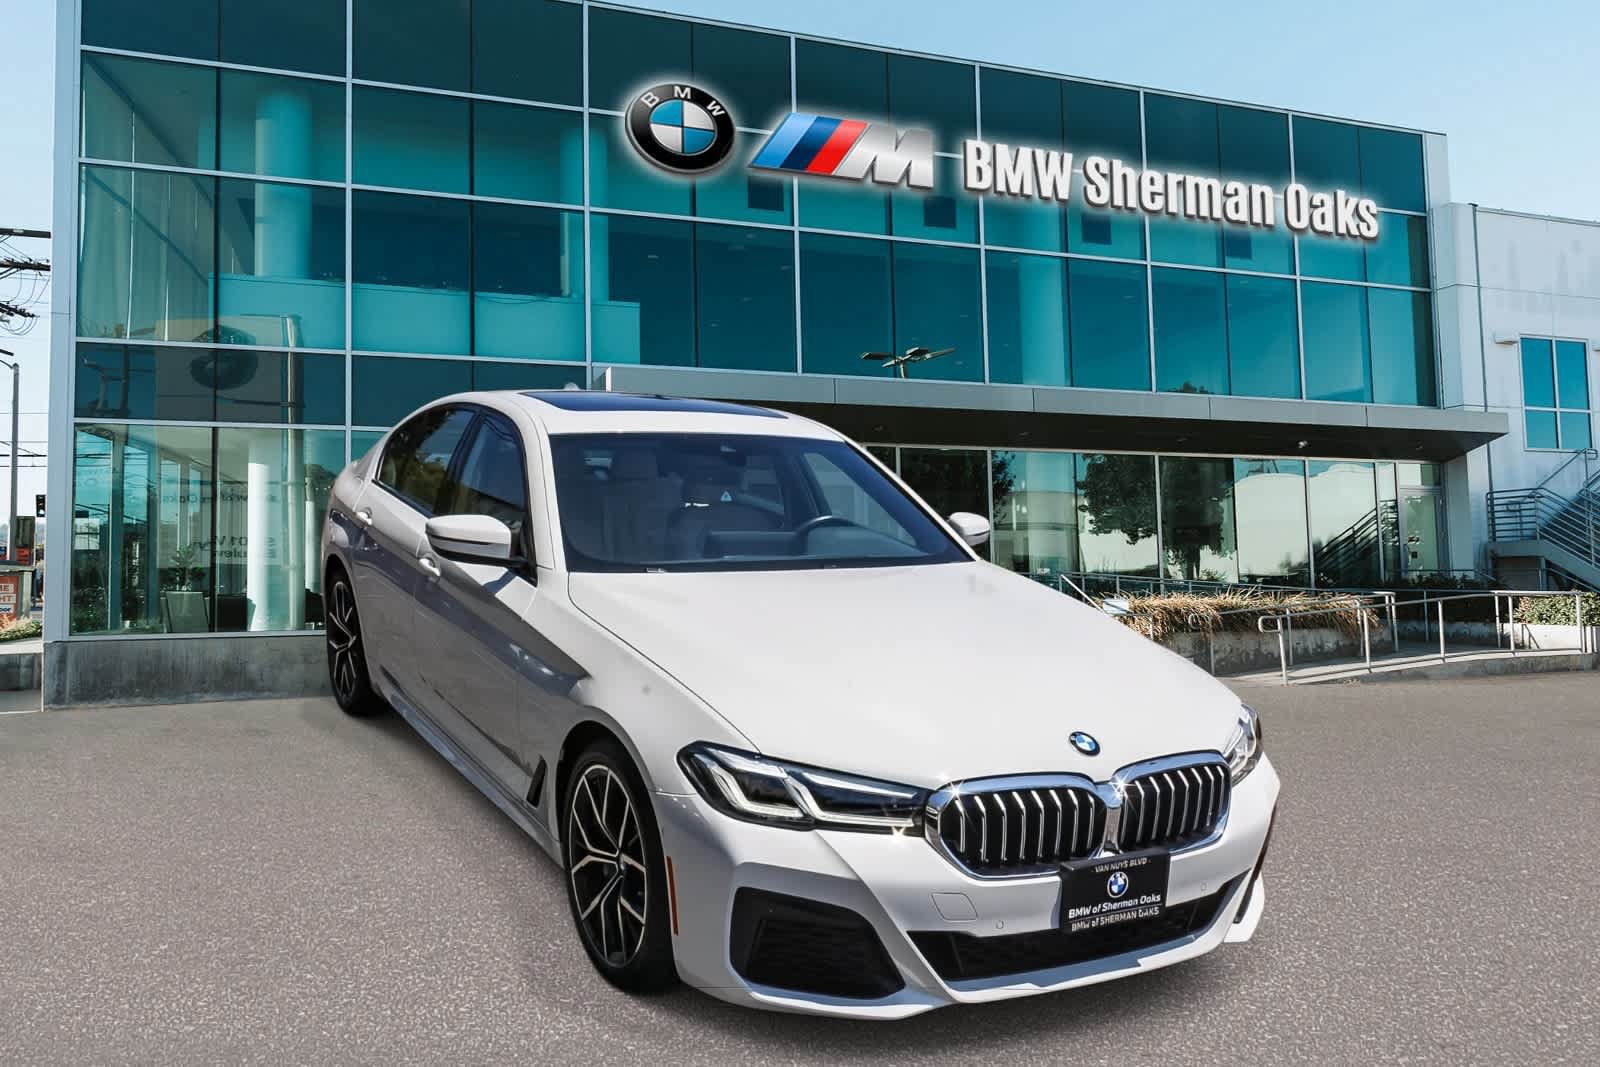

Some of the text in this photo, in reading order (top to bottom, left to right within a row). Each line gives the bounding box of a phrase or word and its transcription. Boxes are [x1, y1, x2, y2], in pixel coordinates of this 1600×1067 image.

[641, 86, 726, 117] BMW
[964, 140, 1379, 240] BMW Sherman Oaks
[1095, 858, 1147, 873] VAN NUYS BLVD
[1068, 894, 1161, 918] BMW of Sherman Oaks
[1071, 907, 1160, 932] BMW of SHERMAN OAKS
